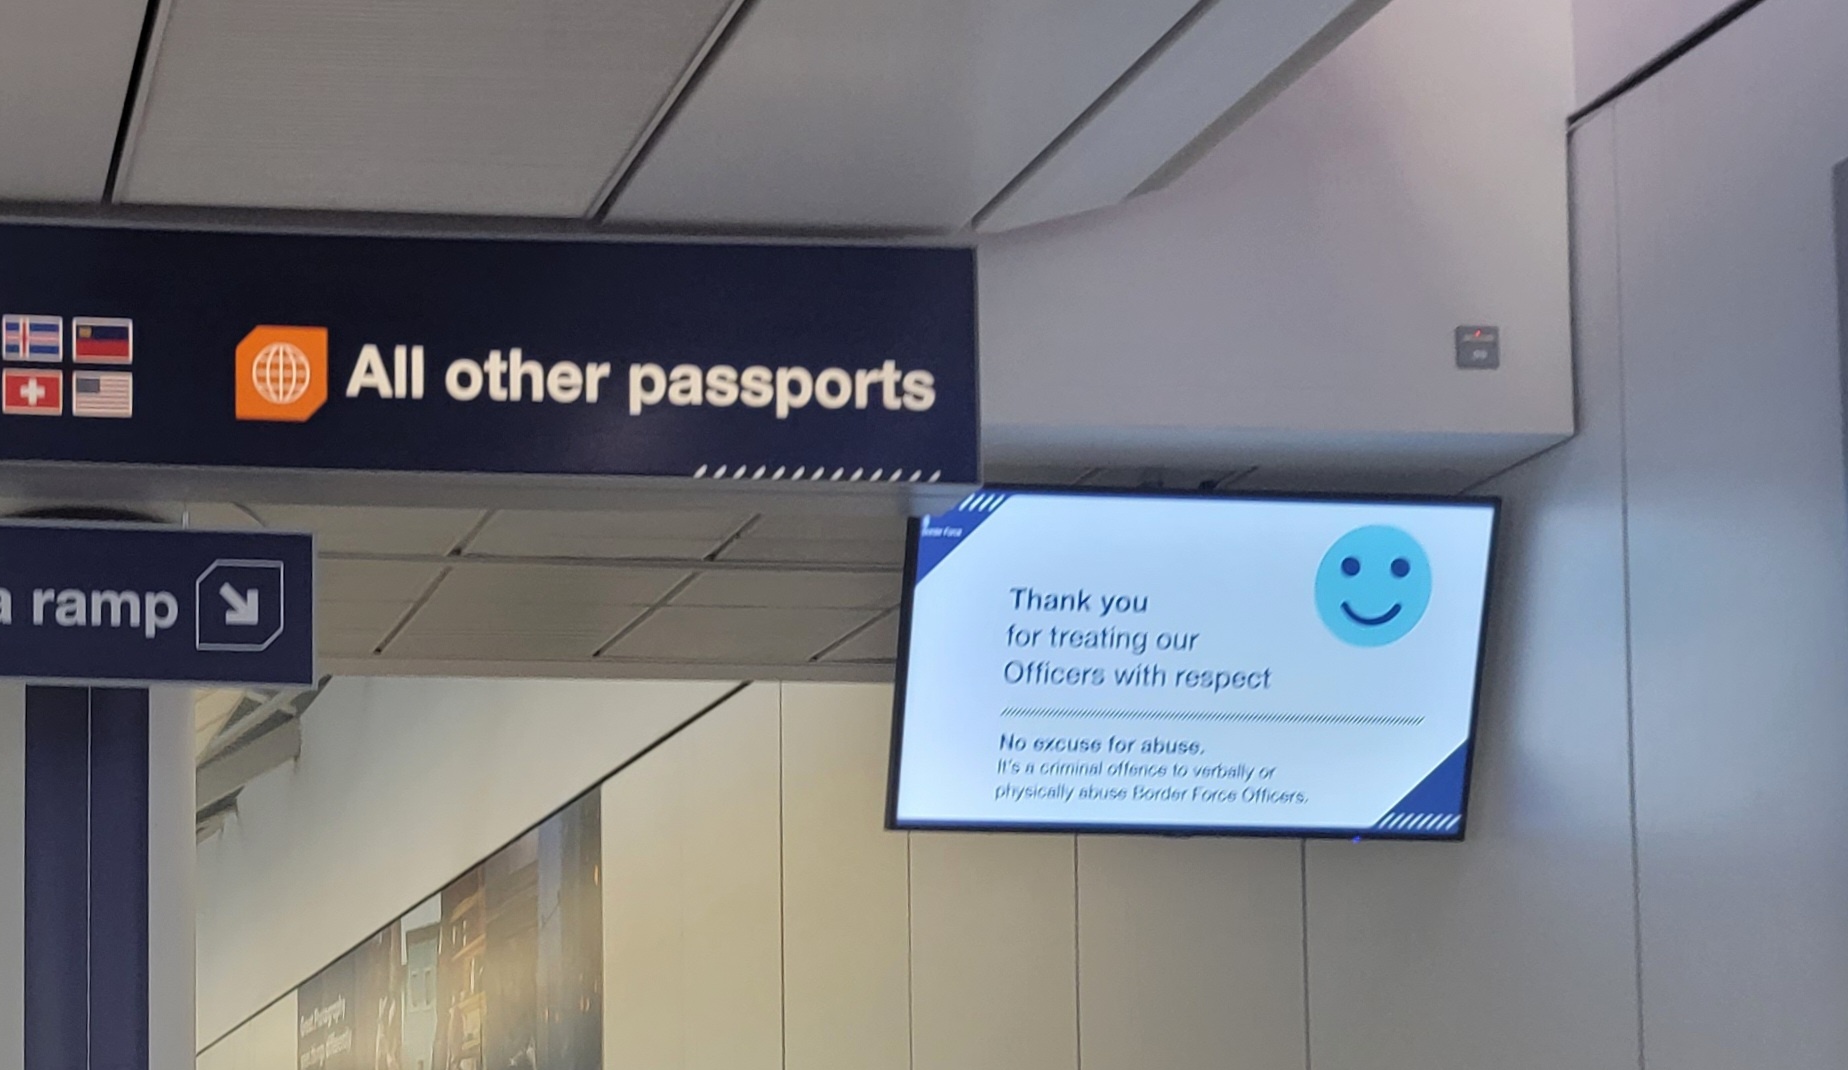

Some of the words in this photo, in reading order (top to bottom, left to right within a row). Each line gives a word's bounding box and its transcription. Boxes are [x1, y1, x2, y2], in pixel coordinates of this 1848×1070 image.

[345, 342, 425, 400] All
[444, 347, 611, 404] other
[628, 358, 936, 418] passports
[31, 584, 179, 638] ramp
[1009, 587, 1092, 612] Thank
[1101, 595, 1150, 617] you
[1006, 623, 1042, 647] for
[1050, 626, 1149, 656] treating
[1156, 632, 1200, 650] our
[1003, 660, 1105, 686] Officers
[1114, 663, 1167, 687] with
[1175, 667, 1273, 694] respect
[1000, 733, 1026, 752] No
[1033, 738, 1102, 753] excuse
[1108, 735, 1137, 754] for
[1140, 736, 1205, 755] abuse.
[997, 759, 1020, 775] It's
[1025, 764, 1034, 775] a
[1040, 760, 1103, 776] criminal
[1107, 761, 1167, 777] offence
[1173, 762, 1188, 777] to
[1193, 763, 1254, 783] verbally
[1259, 766, 1277, 779] or
[995, 783, 1075, 803] physically
[1078, 785, 1127, 800] abuse
[1132, 785, 1188, 801] Border
[1192, 786, 1237, 801] Force
[1241, 787, 1309, 805] Officers.
